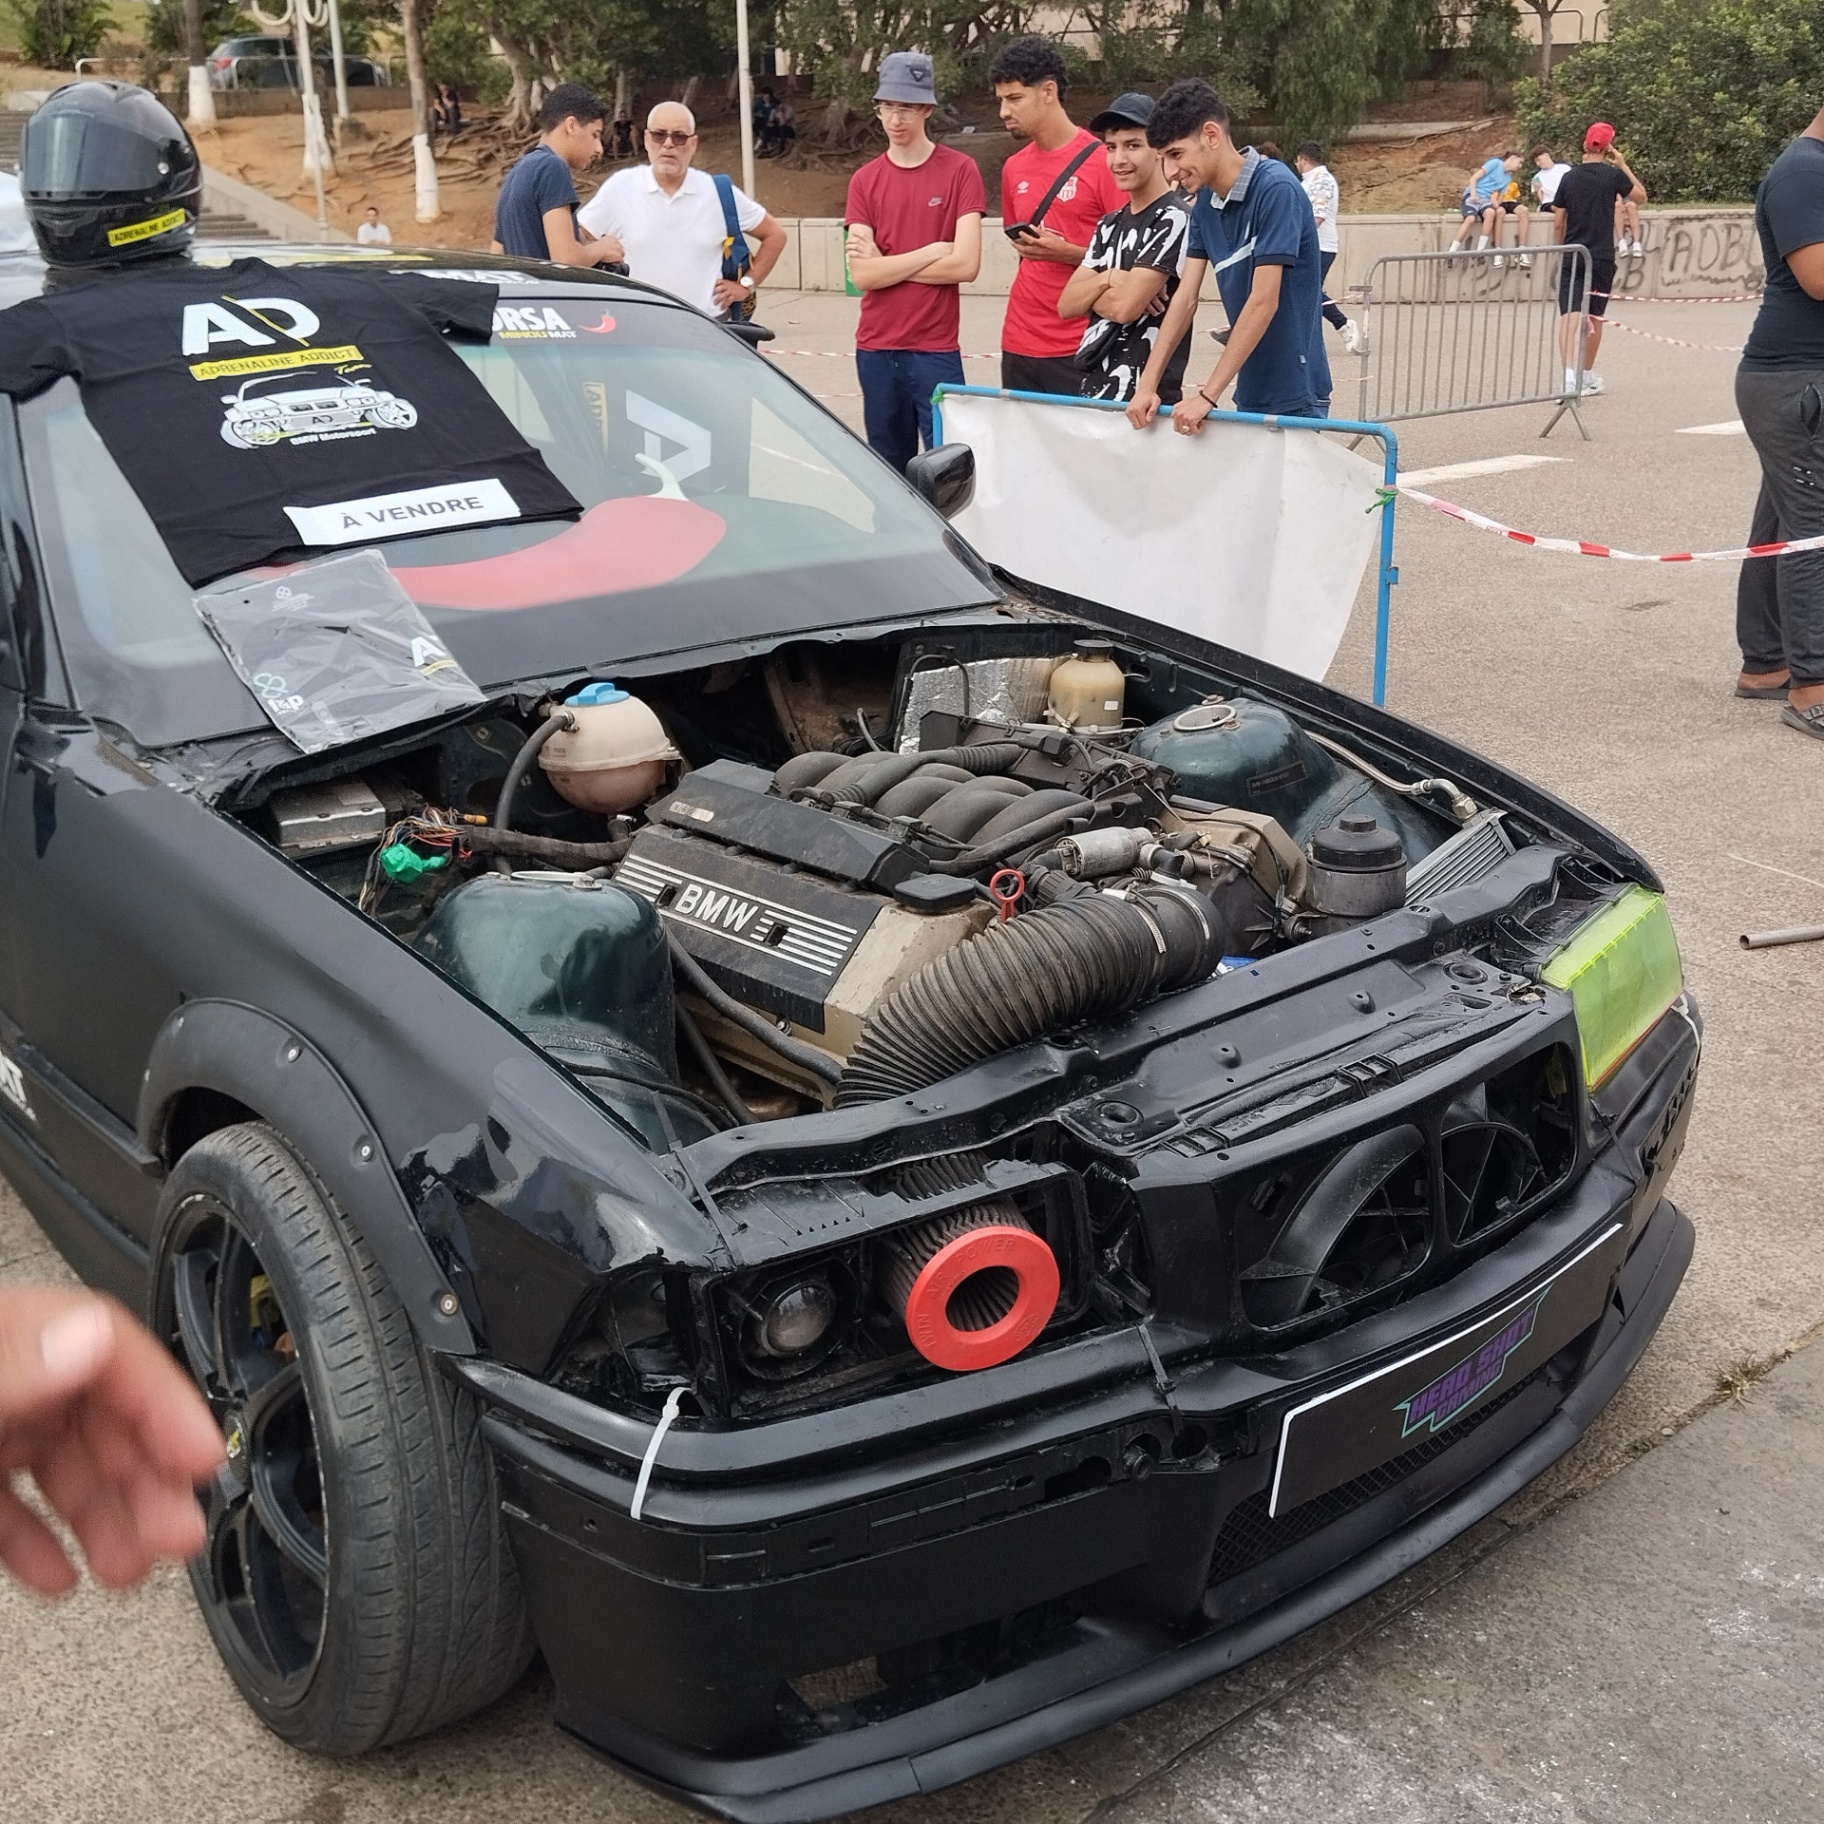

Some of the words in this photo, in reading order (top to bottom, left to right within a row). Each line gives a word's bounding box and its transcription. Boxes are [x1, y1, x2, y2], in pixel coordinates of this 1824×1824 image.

[182, 296, 320, 356] AD
[199, 355, 294, 378] ADRENALINE
[299, 349, 354, 364] ADDICT
[342, 512, 363, 530] À
[365, 496, 485, 523] VENDRE
[674, 883, 760, 933] BMW
[955, 1238, 1016, 1262] POWER
[1409, 1360, 1473, 1424] HEAD
[1476, 1309, 1535, 1376] SHOT
[1435, 1358, 1503, 1423] GAMING
